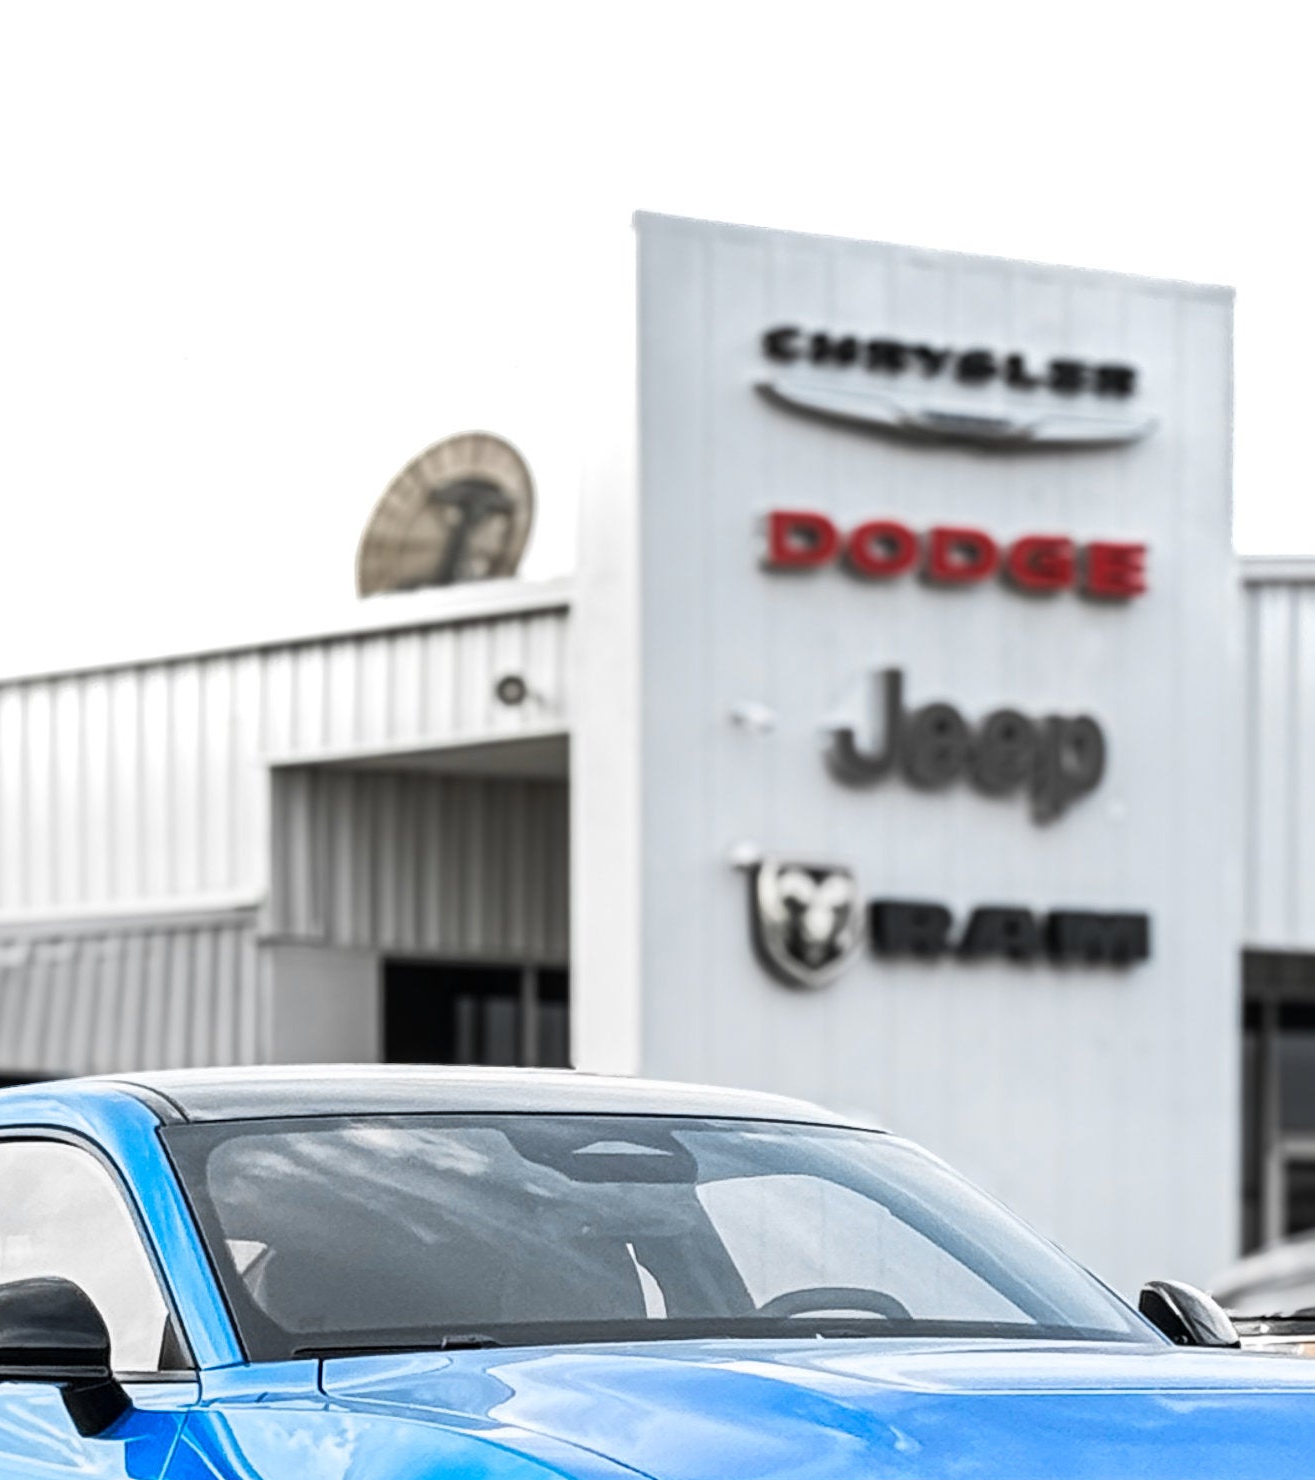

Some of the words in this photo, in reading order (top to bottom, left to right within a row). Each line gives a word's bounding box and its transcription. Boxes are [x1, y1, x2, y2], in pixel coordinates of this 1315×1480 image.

[761, 324, 1138, 398] CHRYSLER
[765, 510, 1149, 600] DODGE
[825, 668, 1107, 828] Jeep
[865, 899, 1151, 972] RAM
